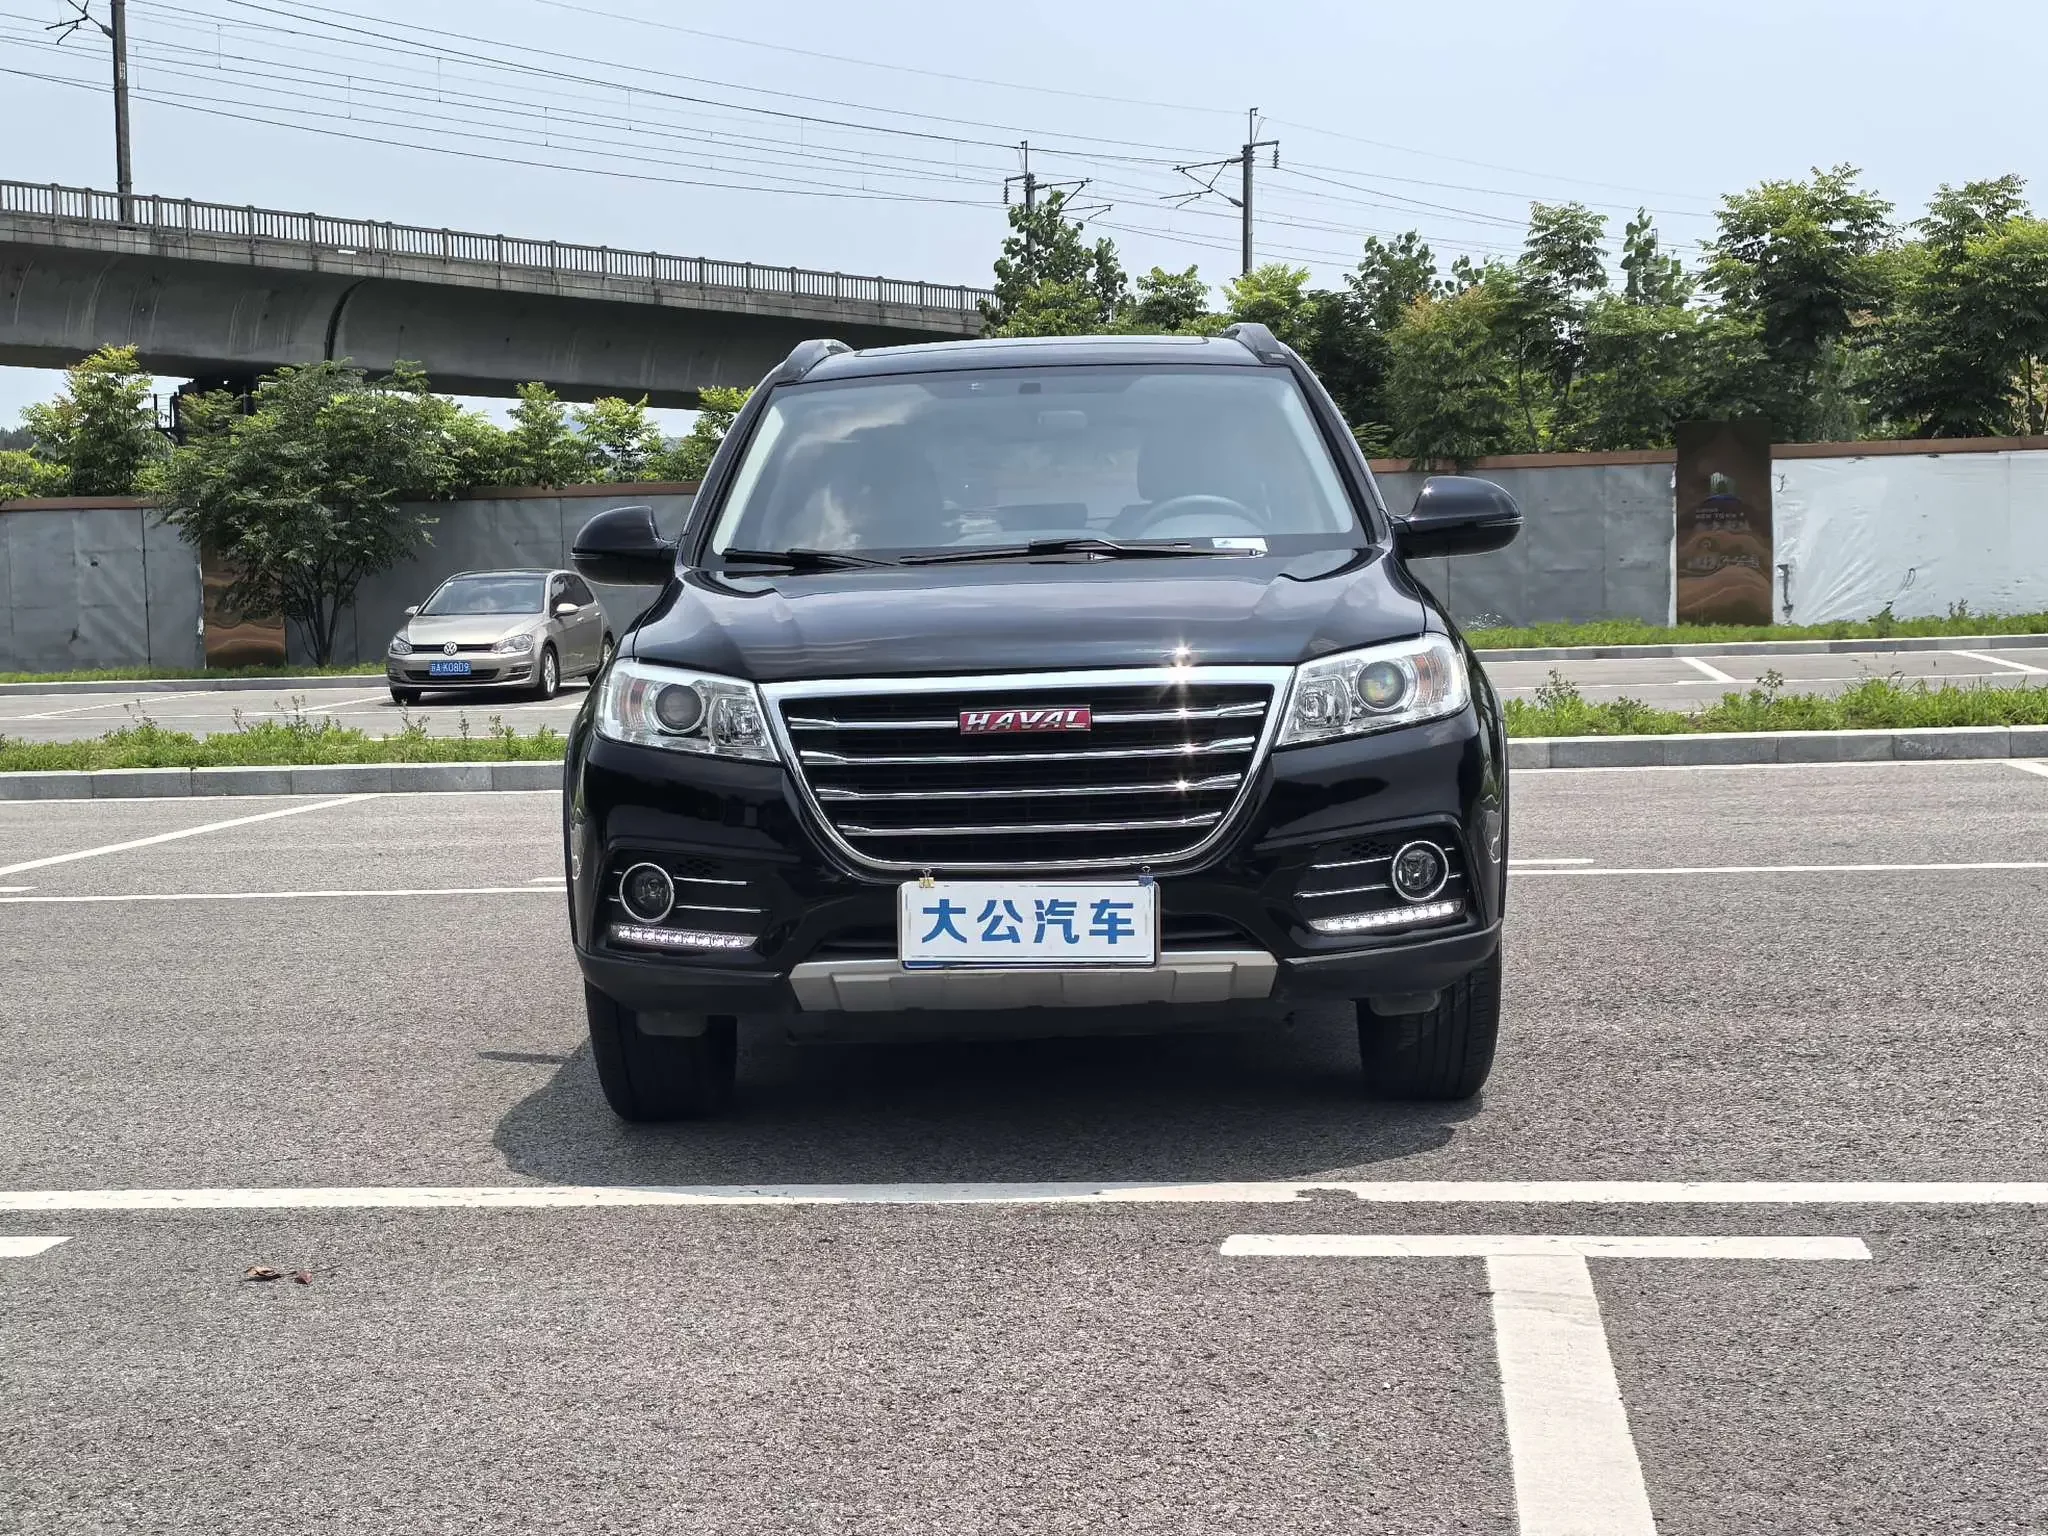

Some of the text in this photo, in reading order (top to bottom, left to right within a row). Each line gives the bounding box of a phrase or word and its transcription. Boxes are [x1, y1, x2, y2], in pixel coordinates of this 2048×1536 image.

[967, 710, 1087, 731] HAVAL
[921, 898, 1135, 945] 大公汽车
